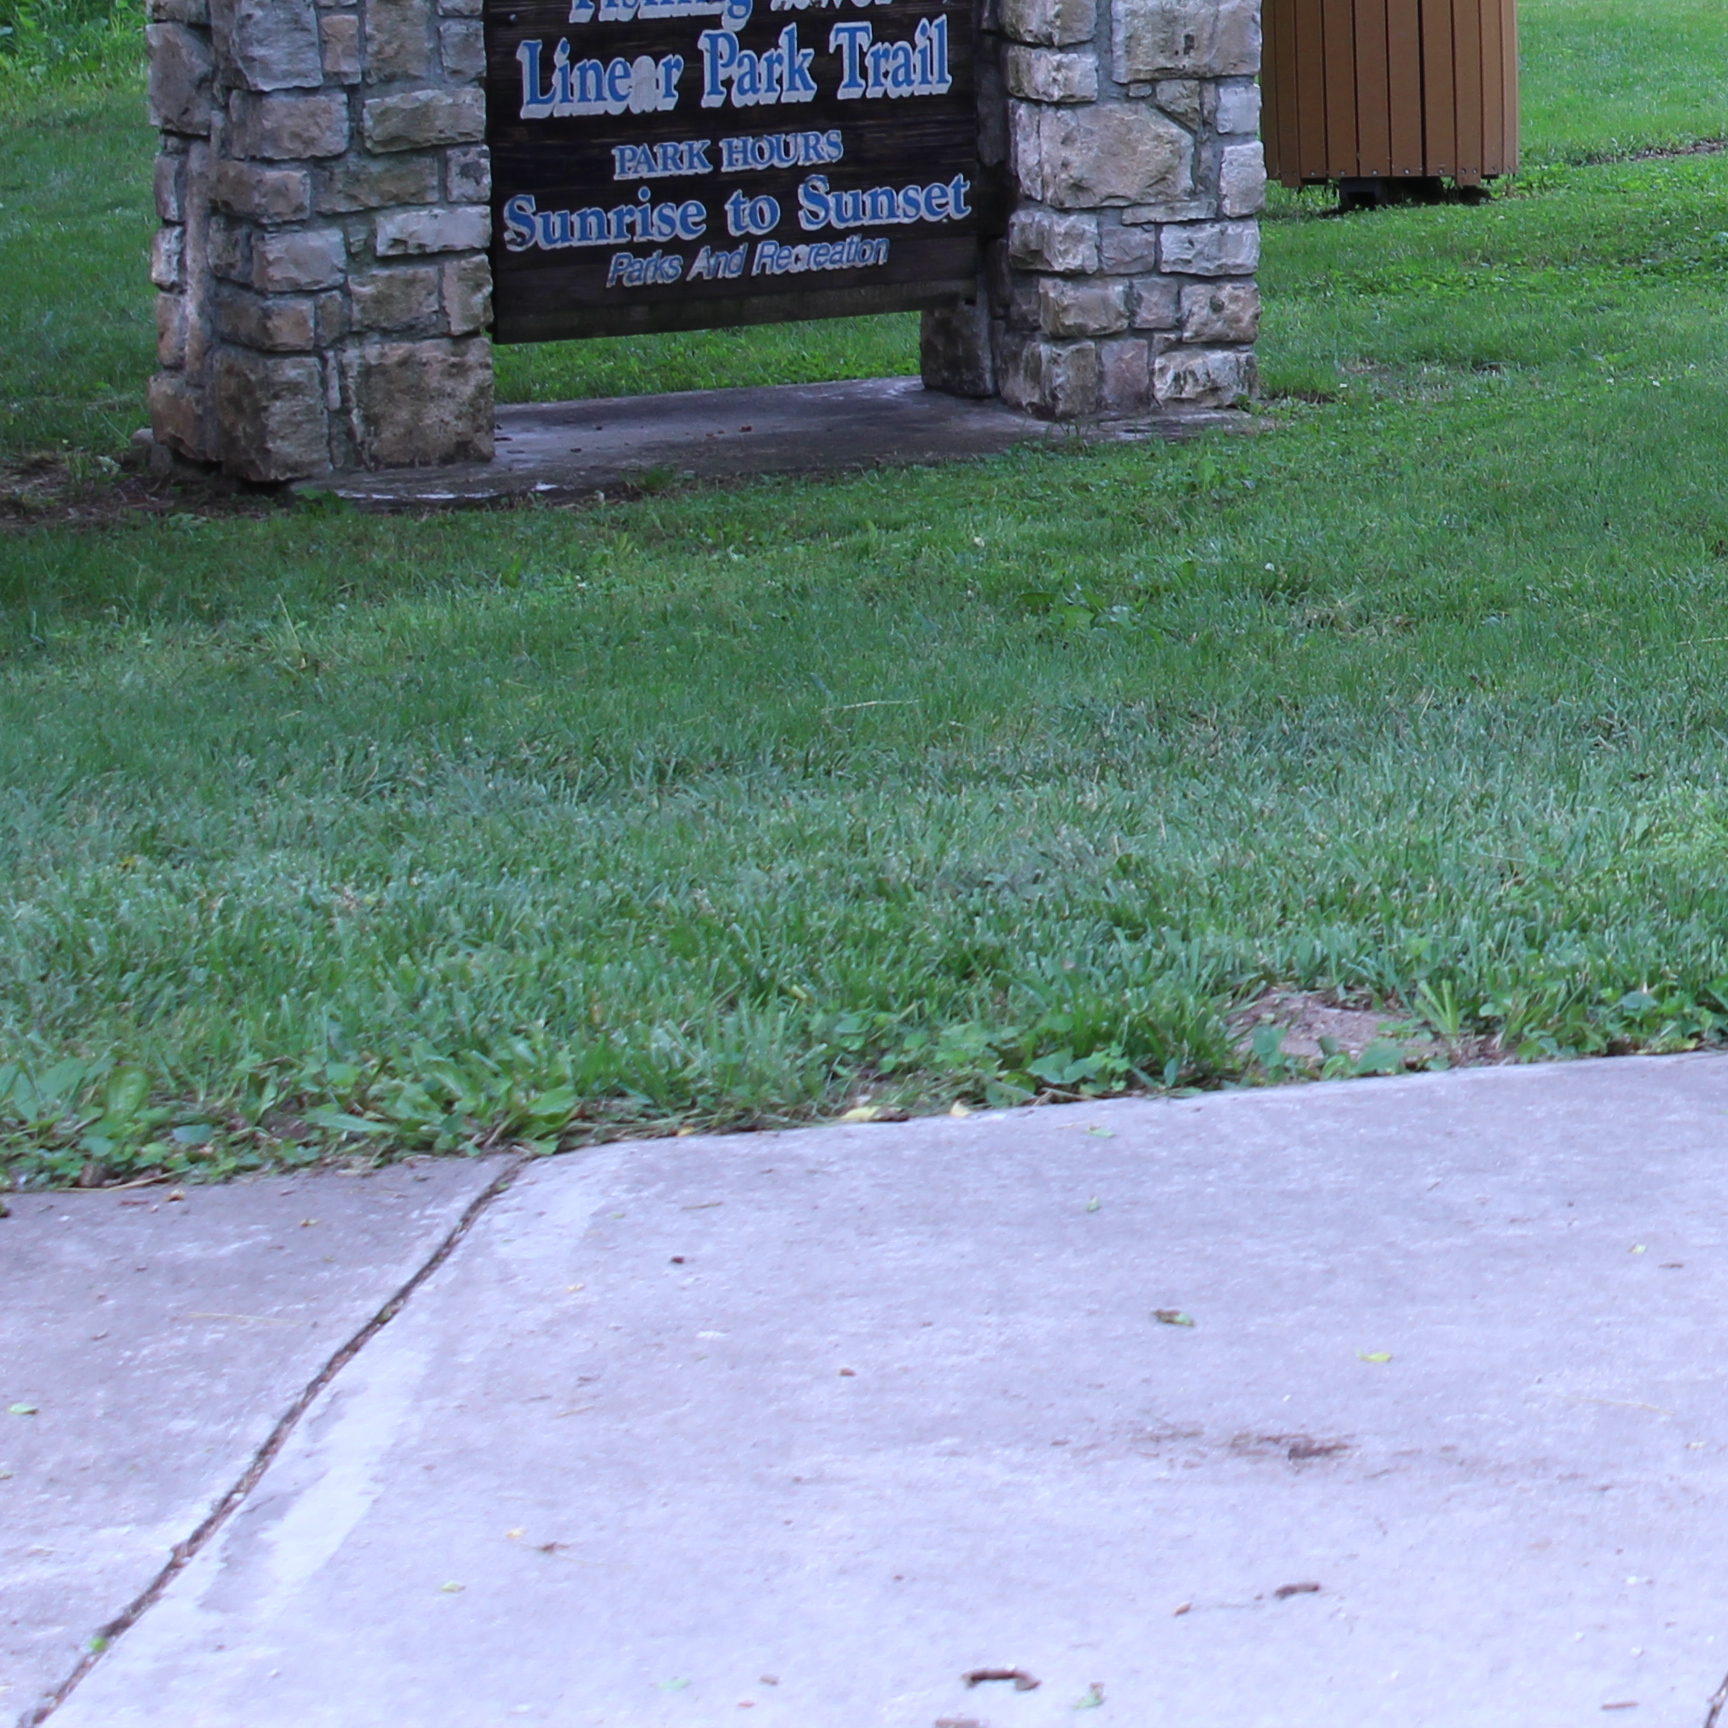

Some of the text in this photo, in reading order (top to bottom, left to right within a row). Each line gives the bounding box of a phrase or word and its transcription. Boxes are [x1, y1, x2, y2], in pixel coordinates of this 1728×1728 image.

[516, 14, 952, 119] Liner Park Trail
[613, 129, 844, 180] PARK HOURS
[504, 173, 972, 251] Sunrise to Sunset
[606, 234, 890, 287] Parks And Recreation
